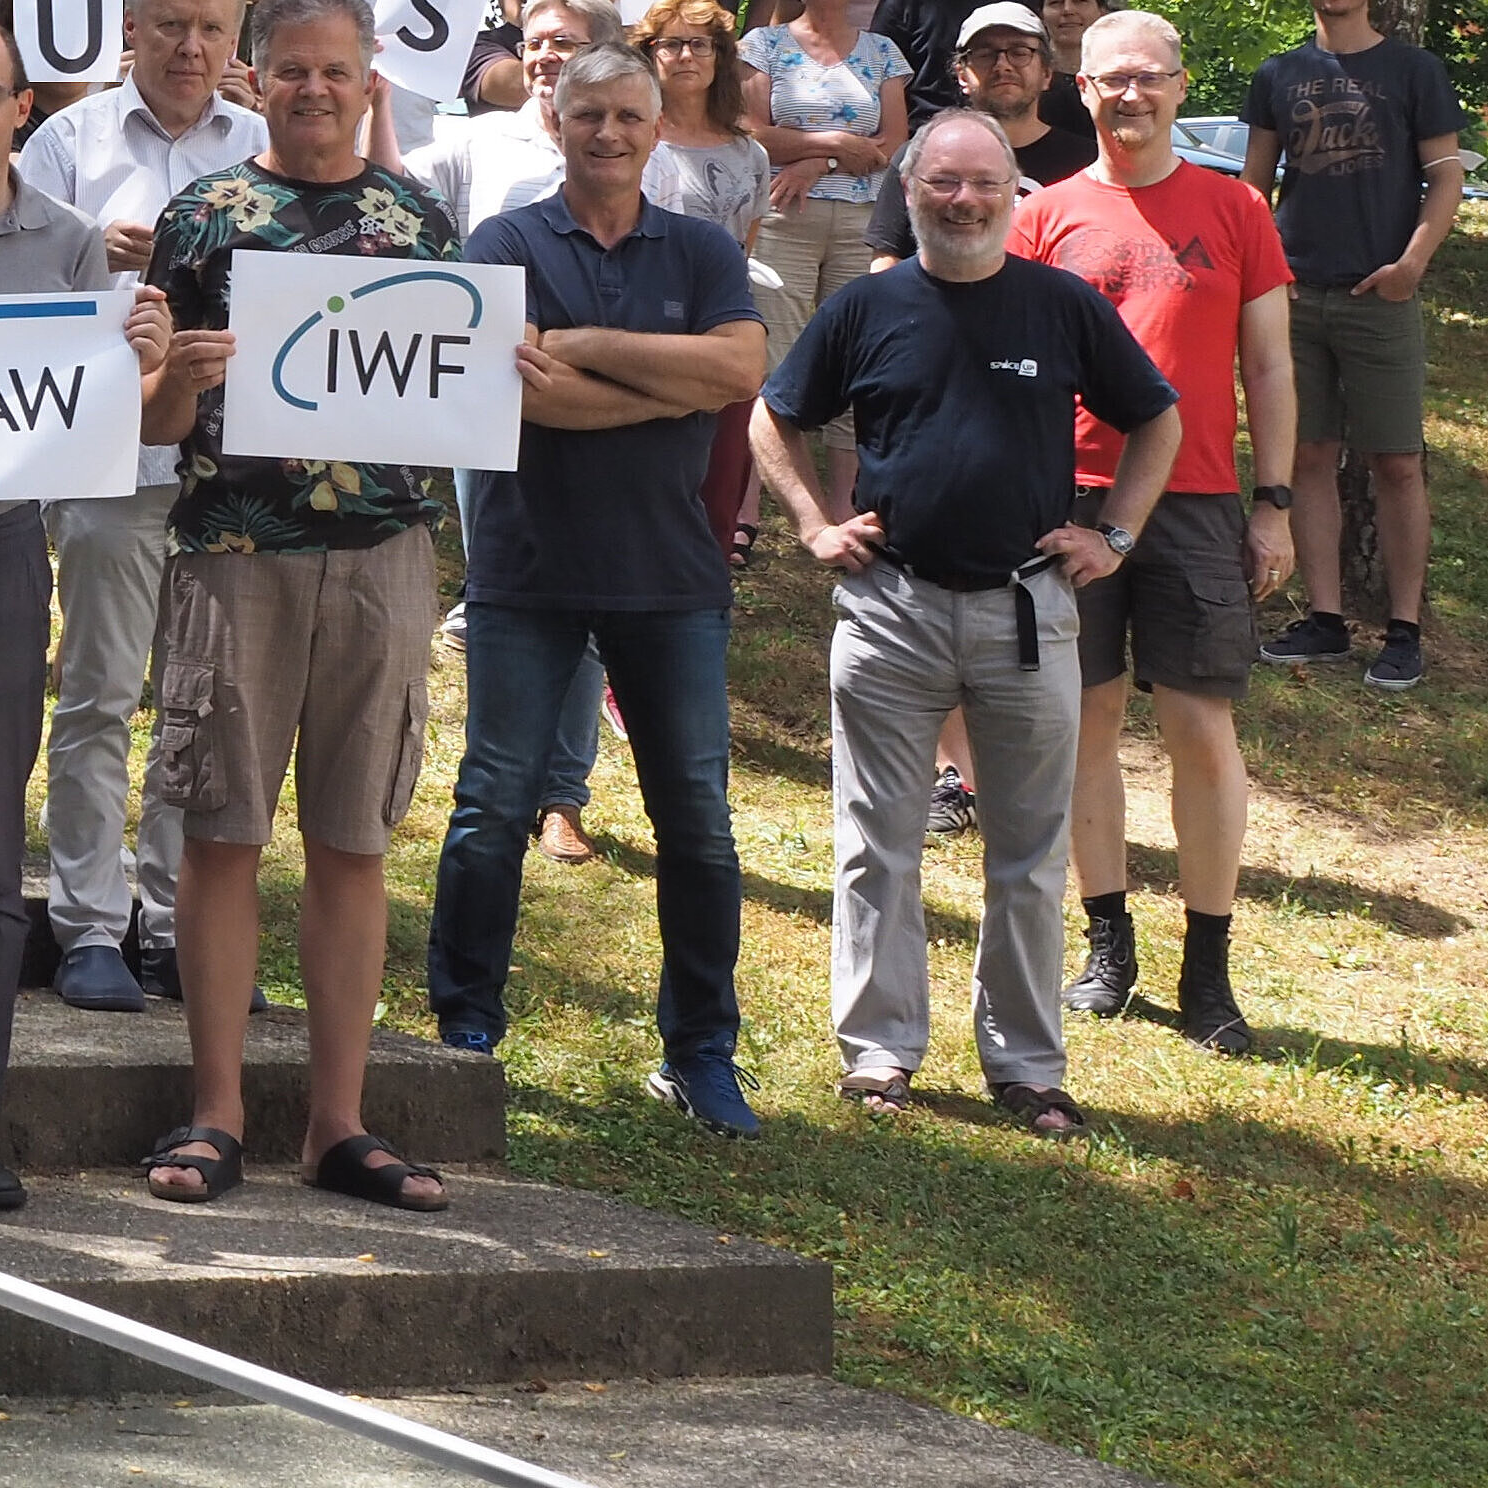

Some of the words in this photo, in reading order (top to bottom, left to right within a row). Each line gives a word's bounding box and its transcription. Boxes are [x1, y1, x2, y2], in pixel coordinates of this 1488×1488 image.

[1286, 79, 1325, 101] THE
[1331, 77, 1388, 100] REAL
[327, 328, 472, 399] IWF
